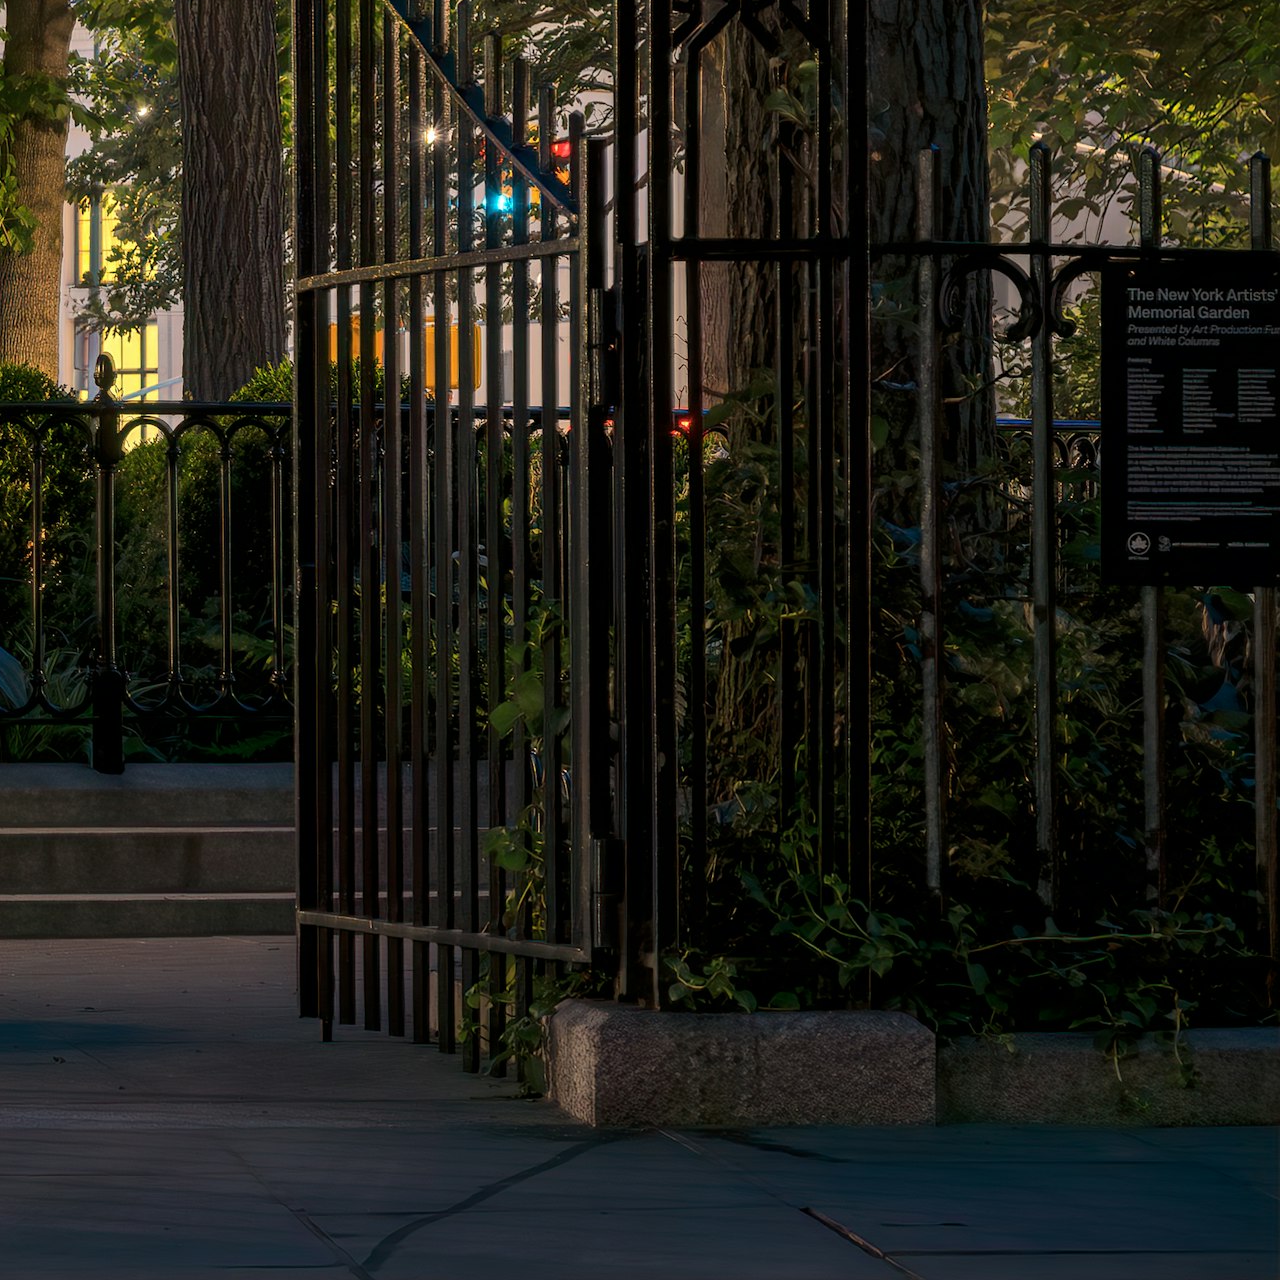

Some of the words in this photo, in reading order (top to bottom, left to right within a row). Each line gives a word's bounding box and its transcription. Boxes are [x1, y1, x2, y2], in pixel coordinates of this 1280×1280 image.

[1127, 287, 1154, 301] The
[1157, 287, 1190, 301] New
[1191, 287, 1224, 301] York
[1128, 305, 1195, 319] Memorial
[1198, 305, 1250, 319] Garden
[1128, 324, 1178, 334] Presented
[1179, 324, 1192, 336] by
[1192, 324, 1208, 334] Art
[1210, 324, 1263, 335] Production
[1127, 336, 1147, 346] and
[1148, 336, 1176, 346] White
[1178, 336, 1220, 346] Columns
